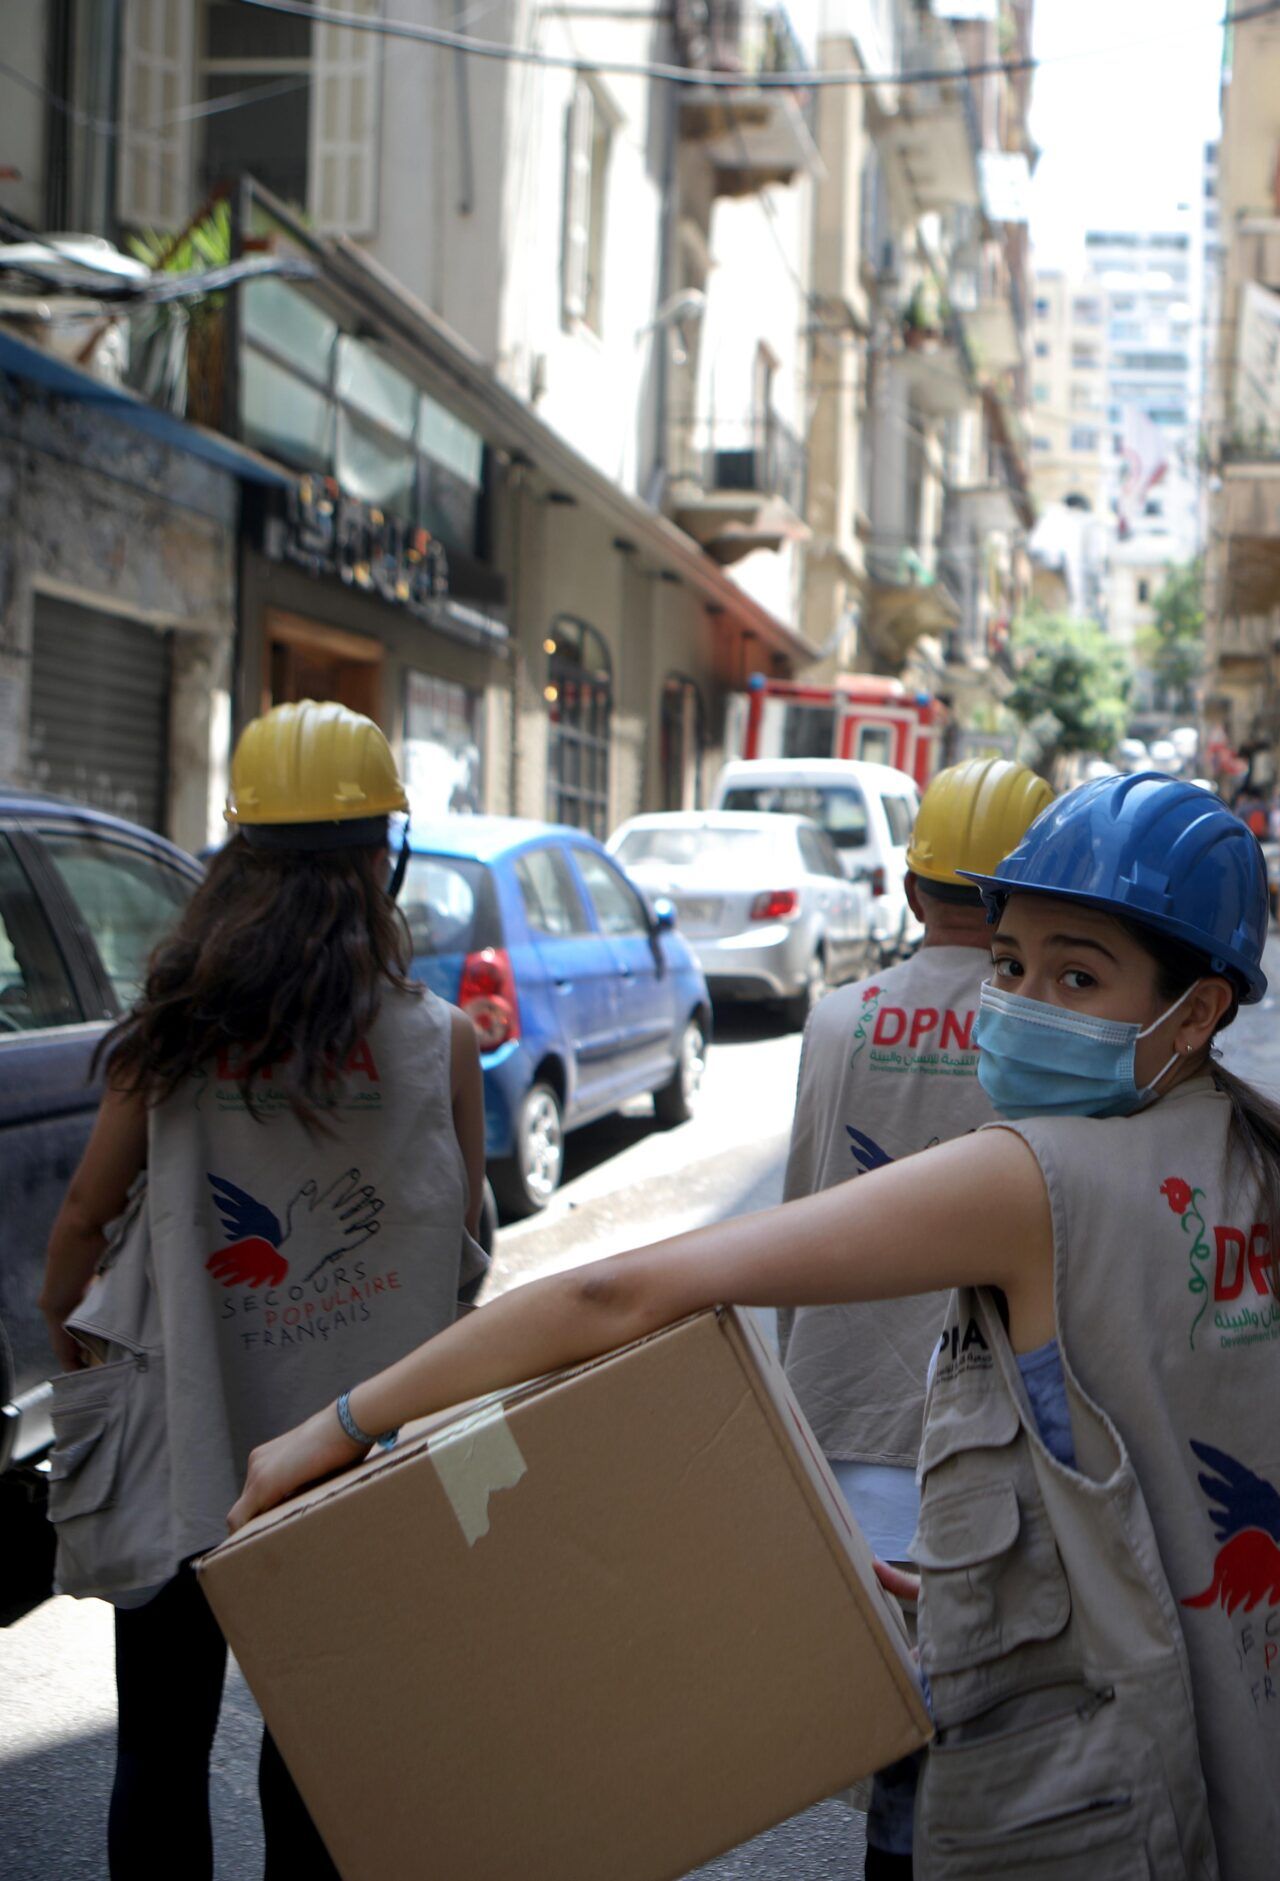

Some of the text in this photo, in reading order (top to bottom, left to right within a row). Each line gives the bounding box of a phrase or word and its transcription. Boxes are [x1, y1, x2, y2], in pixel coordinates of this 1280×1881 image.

[872, 1007, 980, 1050] DPN
[215, 1036, 380, 1082] DA
[220, 1260, 367, 1320] SECOURS
[264, 1270, 402, 1328] POPULAIRE
[240, 1301, 371, 1351] FRANÇAIS
